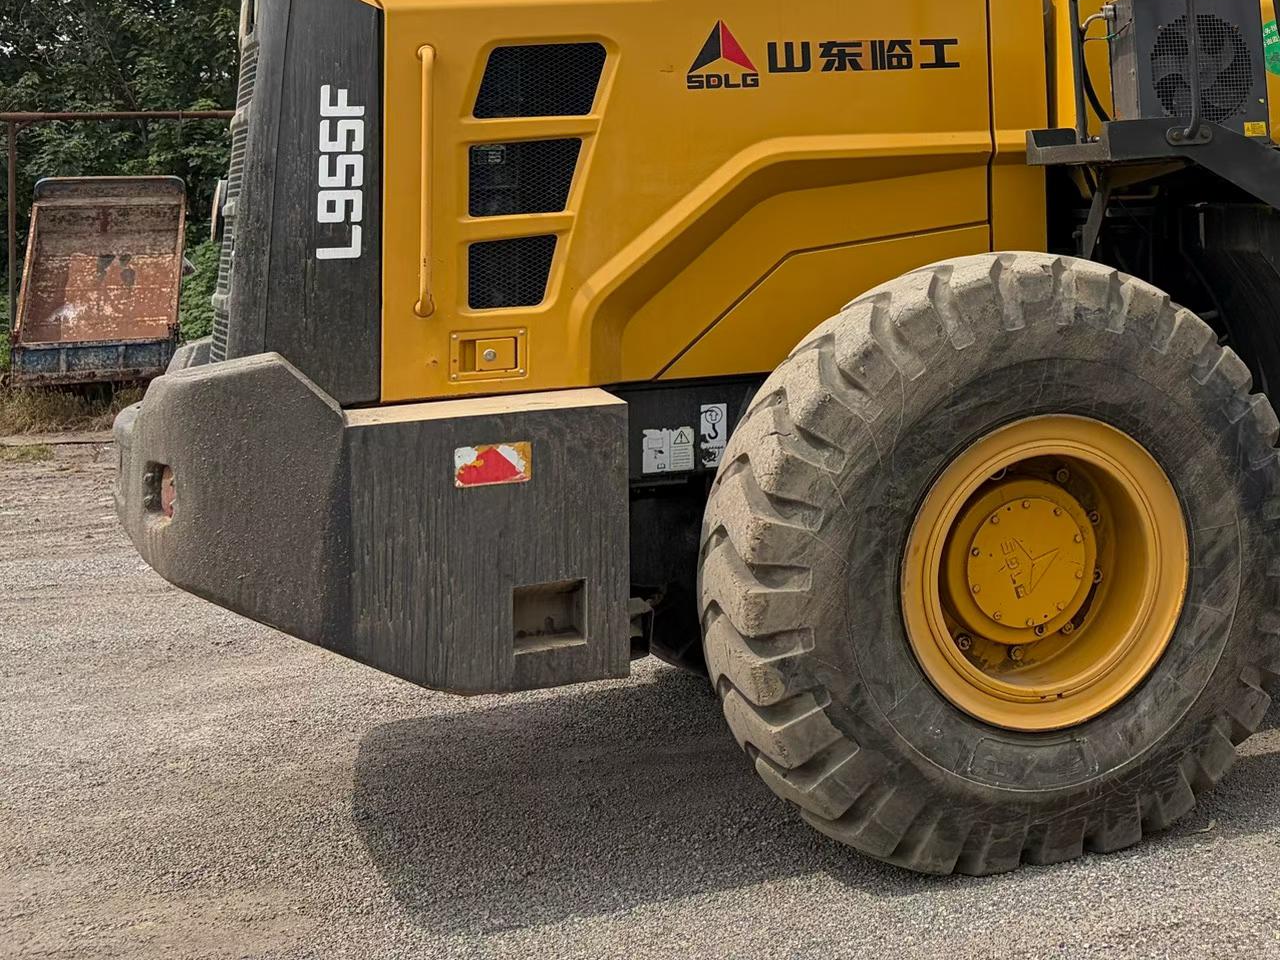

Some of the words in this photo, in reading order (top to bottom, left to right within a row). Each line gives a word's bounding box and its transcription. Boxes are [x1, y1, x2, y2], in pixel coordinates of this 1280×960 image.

[767, 38, 961, 73] 山东临工
[686, 72, 760, 90] SDLG
[315, 84, 365, 260] L955F
